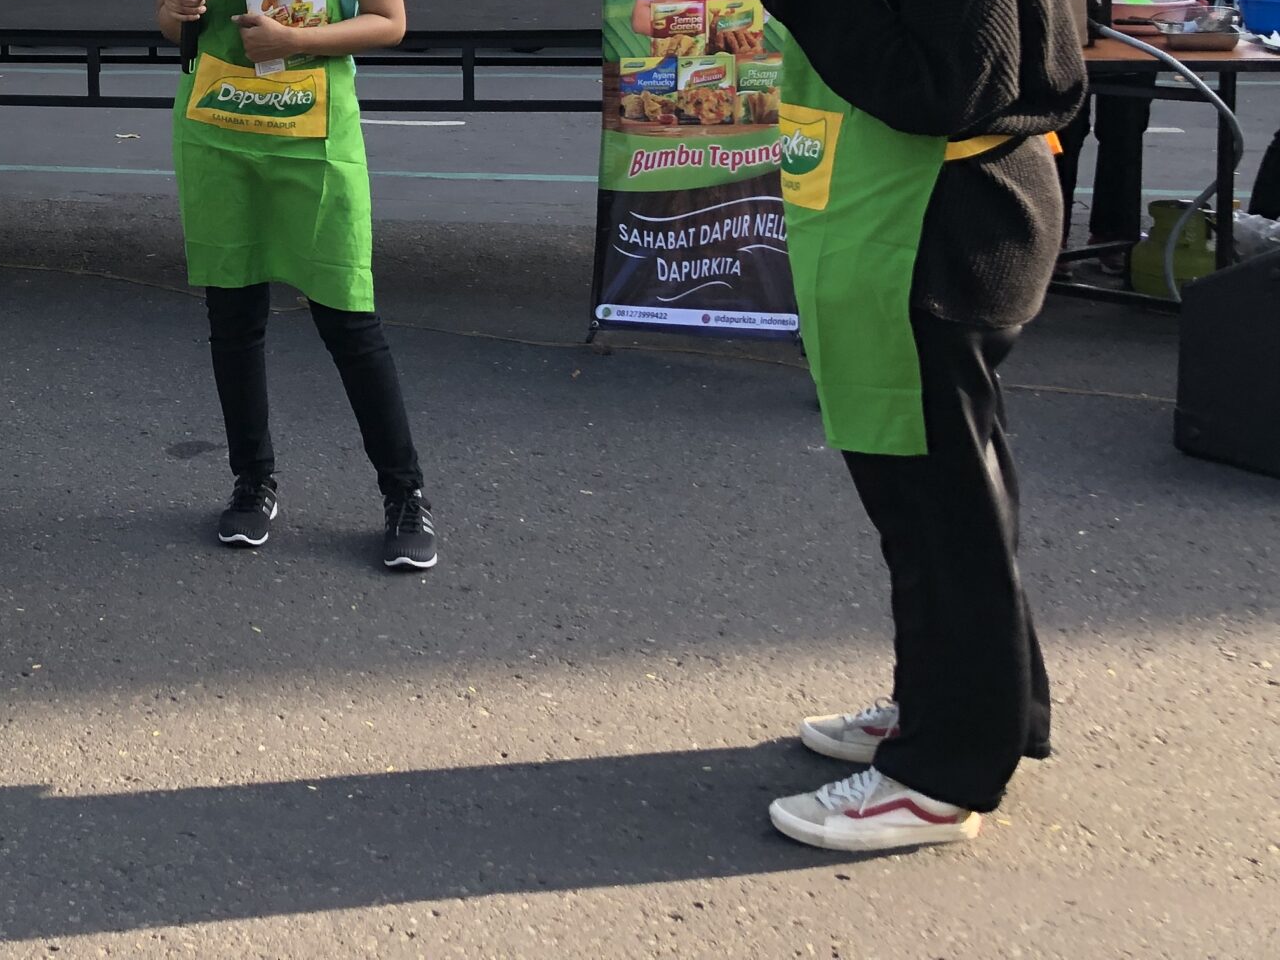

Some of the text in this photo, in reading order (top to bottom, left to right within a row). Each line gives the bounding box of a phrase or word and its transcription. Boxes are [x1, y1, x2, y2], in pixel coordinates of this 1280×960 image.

[673, 16, 703, 25] Tempe
[670, 23, 703, 31] Goreng
[652, 72, 676, 81] Ayam
[748, 69, 778, 79] Pisang
[637, 79, 676, 88] Kentucky
[740, 77, 775, 87] Goreng
[212, 113, 249, 126] SAHABAT
[267, 121, 297, 129] DAPUR
[628, 141, 782, 178] Bumbu Tepung
[619, 224, 695, 250] SAHABAT
[700, 214, 750, 245] DAPUR
[657, 257, 741, 282] DAPURKITA
